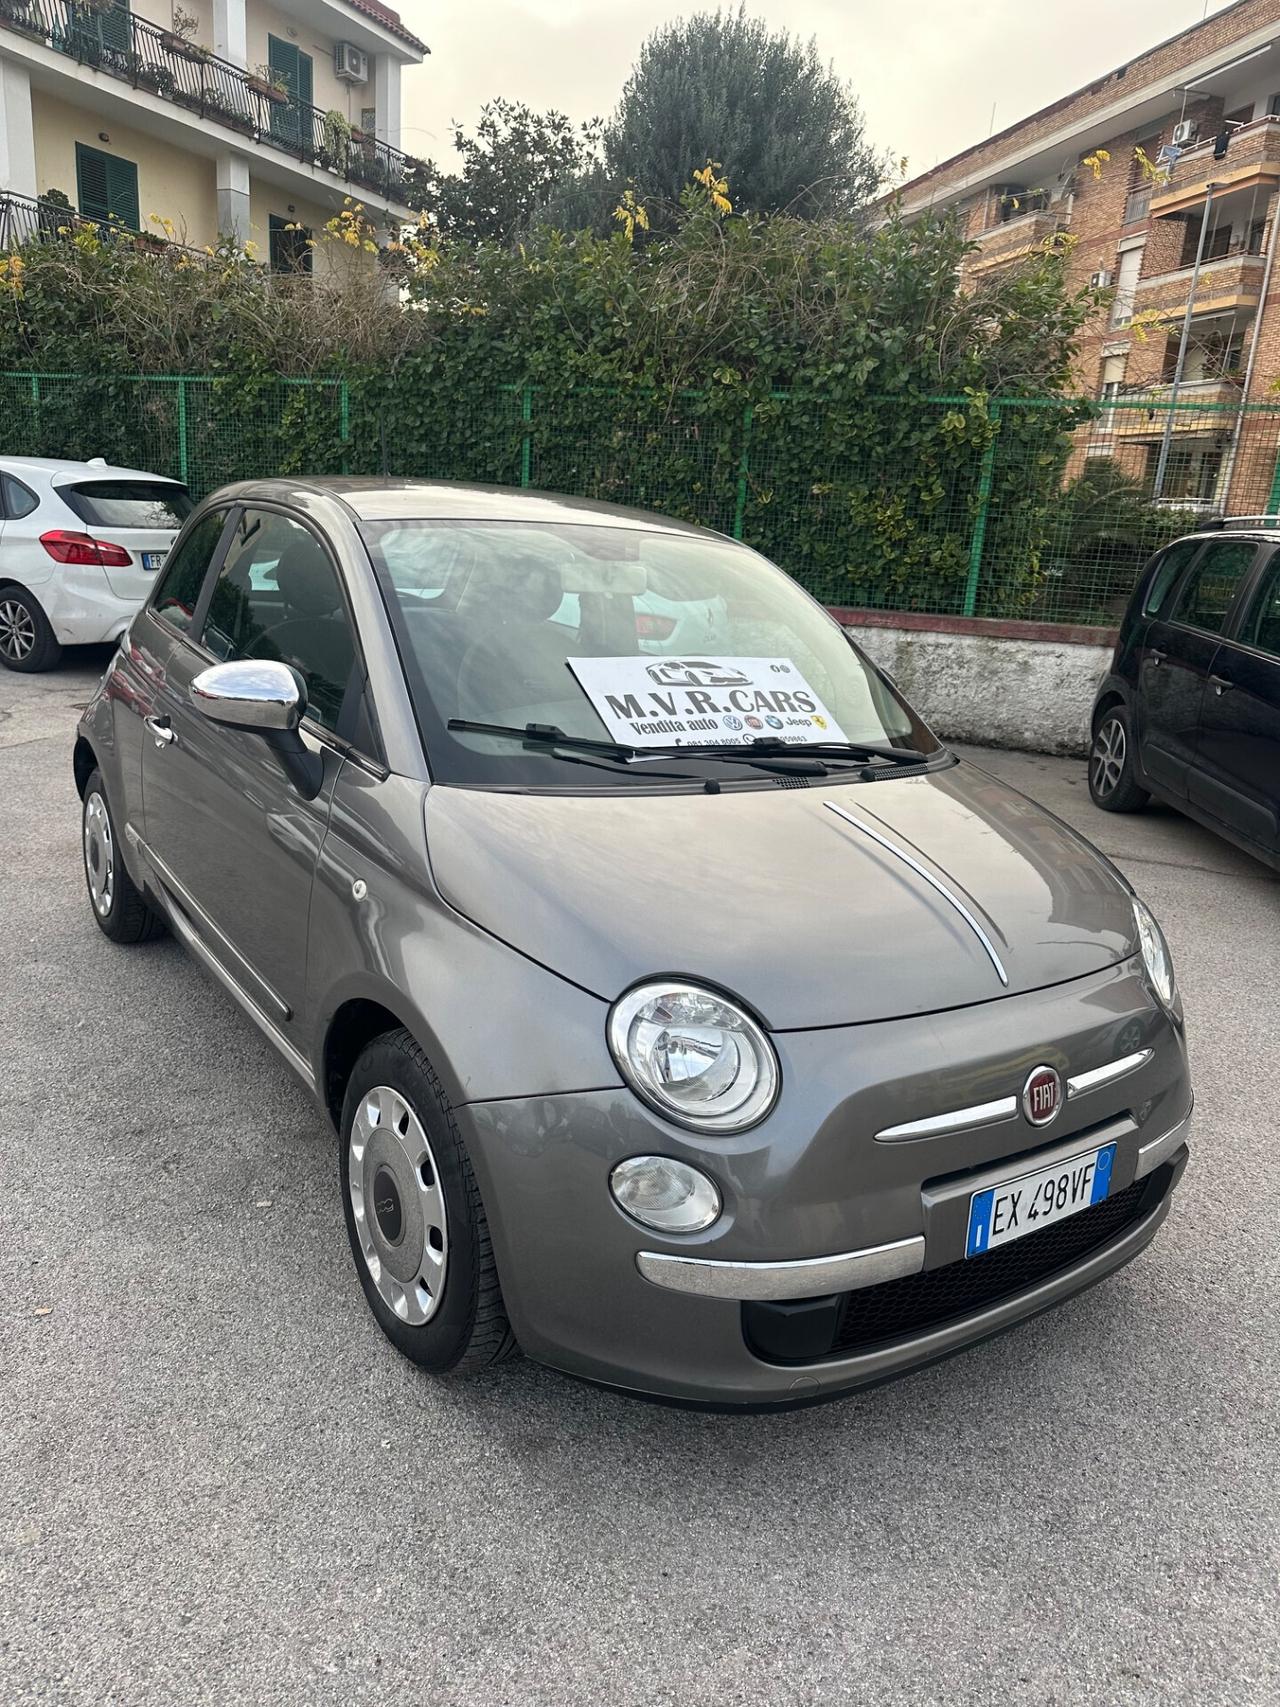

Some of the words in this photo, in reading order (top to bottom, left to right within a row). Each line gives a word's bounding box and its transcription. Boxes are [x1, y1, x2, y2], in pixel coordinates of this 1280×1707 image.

[630, 719, 685, 735] Vendita
[689, 718, 719, 731] auto
[785, 717, 812, 727] Jeep
[1033, 1081, 1055, 1112] FIAT
[992, 1190, 1022, 1236] EX
[1027, 1162, 1096, 1220] 498VF
